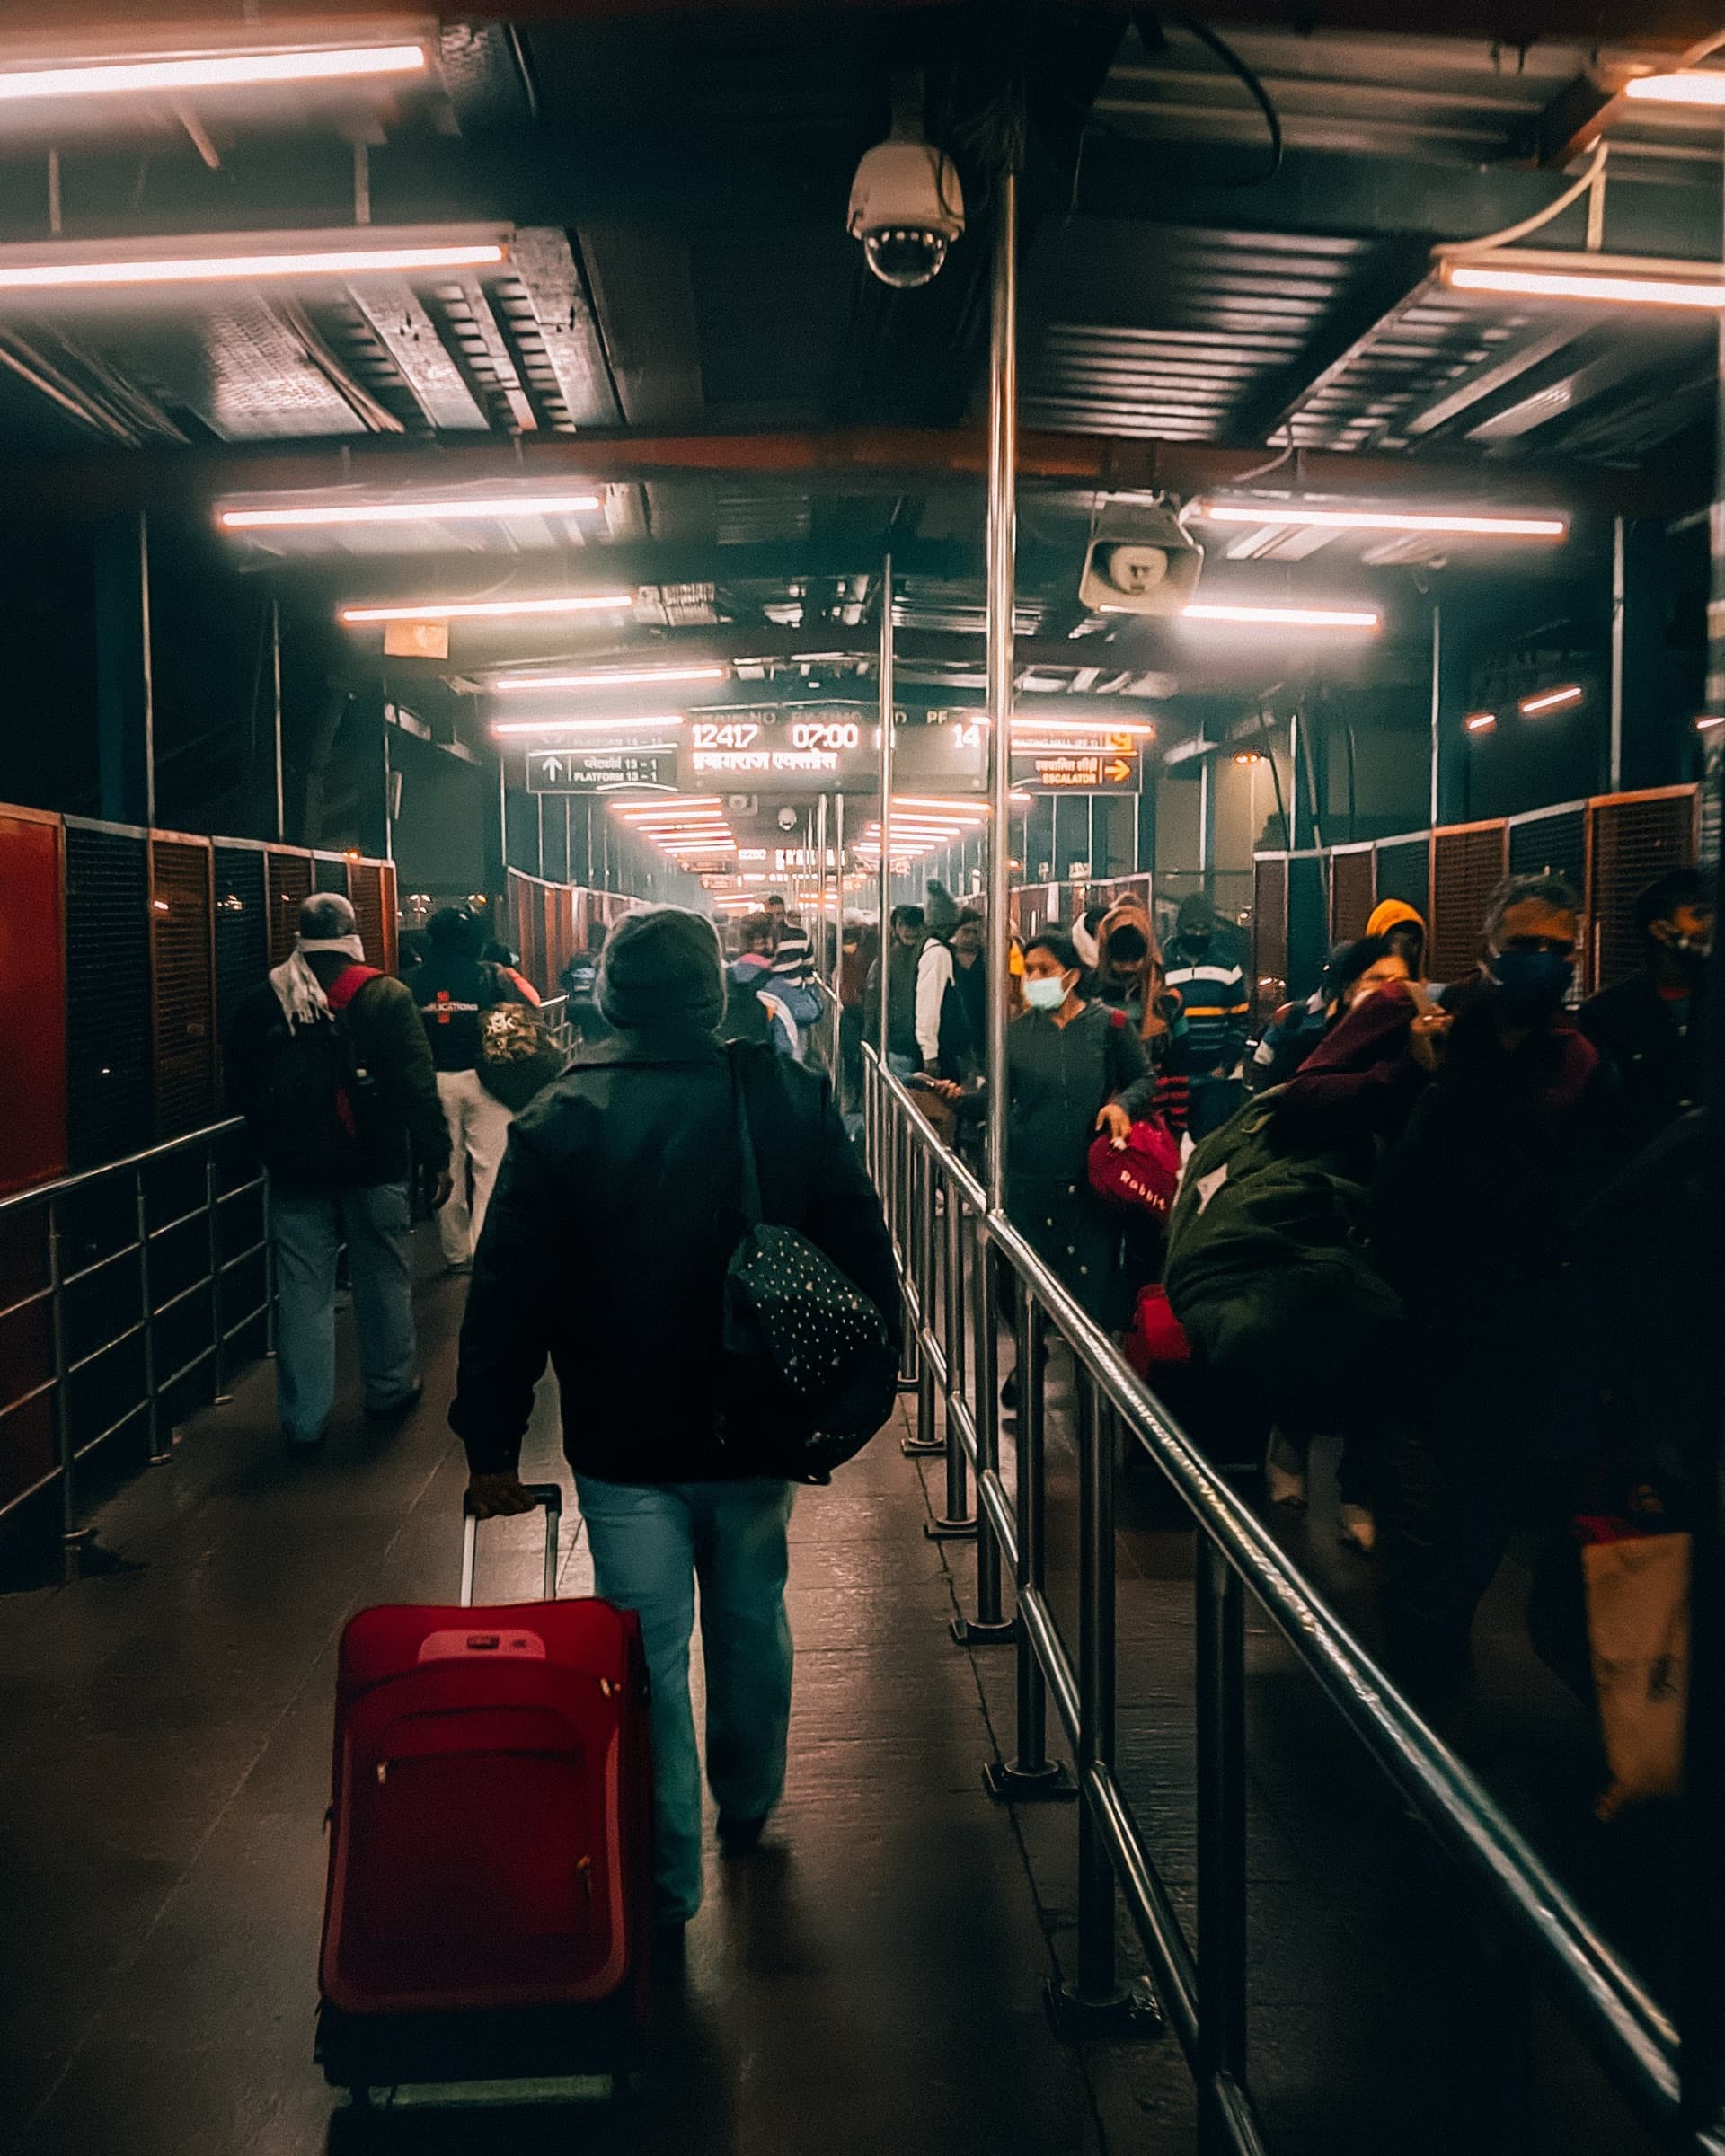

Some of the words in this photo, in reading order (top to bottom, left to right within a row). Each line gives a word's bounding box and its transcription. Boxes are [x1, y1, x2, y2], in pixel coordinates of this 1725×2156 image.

[927, 711, 949, 724] PF
[692, 723, 759, 748] 12417
[792, 723, 859, 748] 07:00
[951, 722, 980, 748] 14
[573, 771, 624, 782] PLATFORM
[650, 771, 658, 782] 1
[1042, 773, 1097, 785] ESCALATOR
